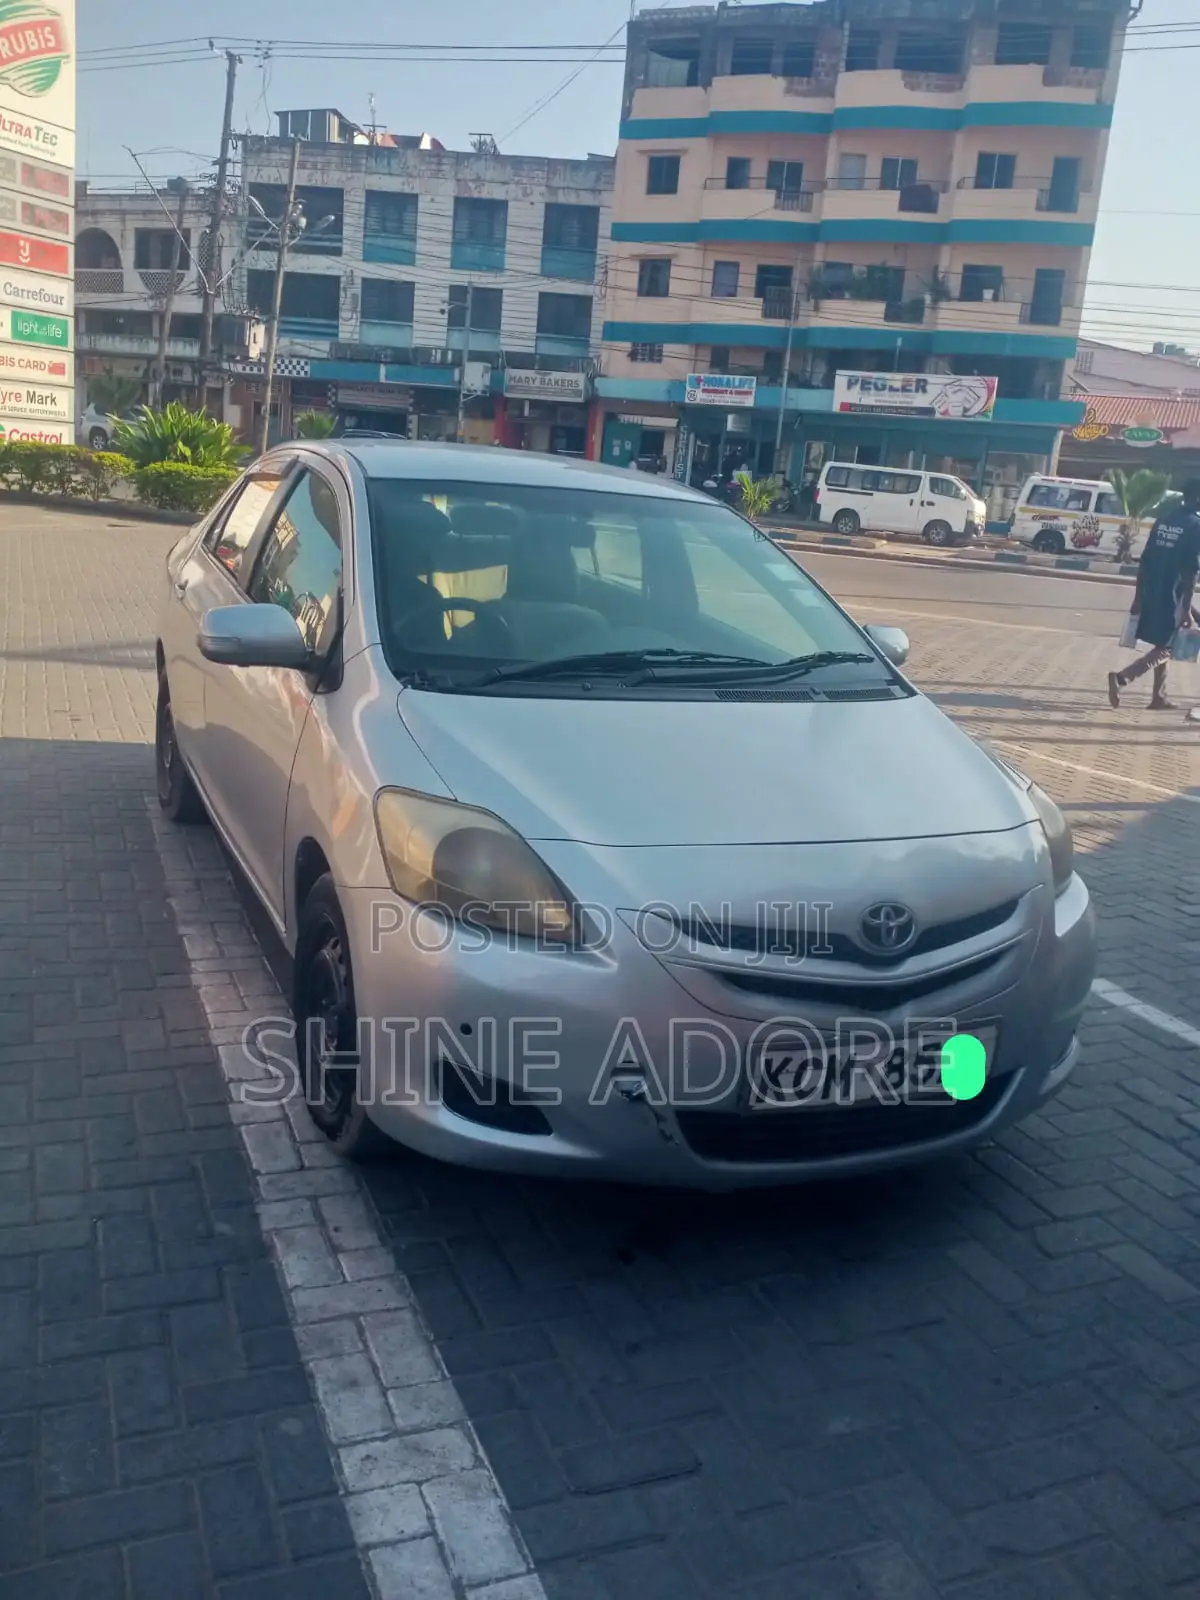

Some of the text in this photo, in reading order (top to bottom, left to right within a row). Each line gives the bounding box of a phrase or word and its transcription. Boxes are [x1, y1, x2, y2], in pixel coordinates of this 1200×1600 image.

[3, 281, 65, 306] Carrefour
[17, 358, 47, 371] CARD
[509, 374, 580, 388] MARY BAKERS
[846, 375, 929, 393] PEGLER
[0, 386, 57, 406] yre Mark
[9, 428, 63, 445] Castrol
[675, 425, 689, 479] CHEMIST
